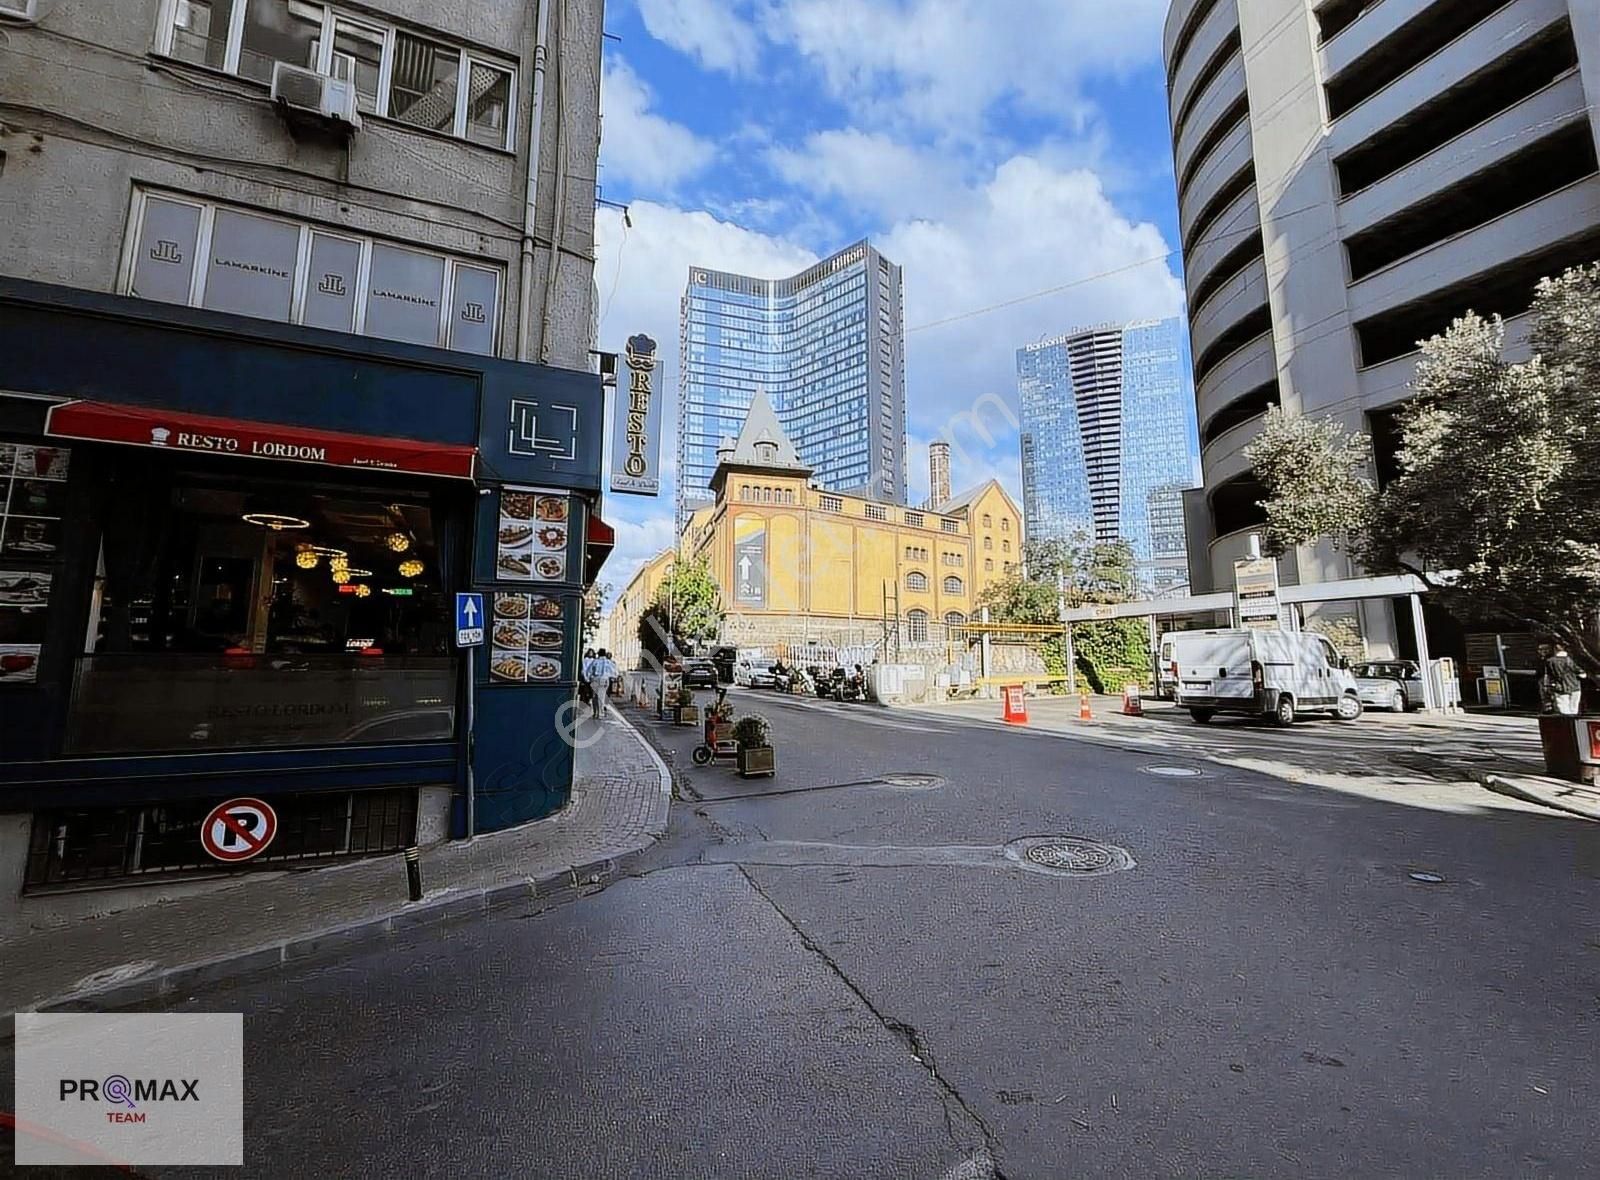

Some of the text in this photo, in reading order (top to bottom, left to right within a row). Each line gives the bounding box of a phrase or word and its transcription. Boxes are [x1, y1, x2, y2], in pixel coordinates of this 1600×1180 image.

[832, 248, 863, 270] Hilton
[624, 370, 652, 477] RESTO
[177, 432, 326, 460] RESTO LORDOM
